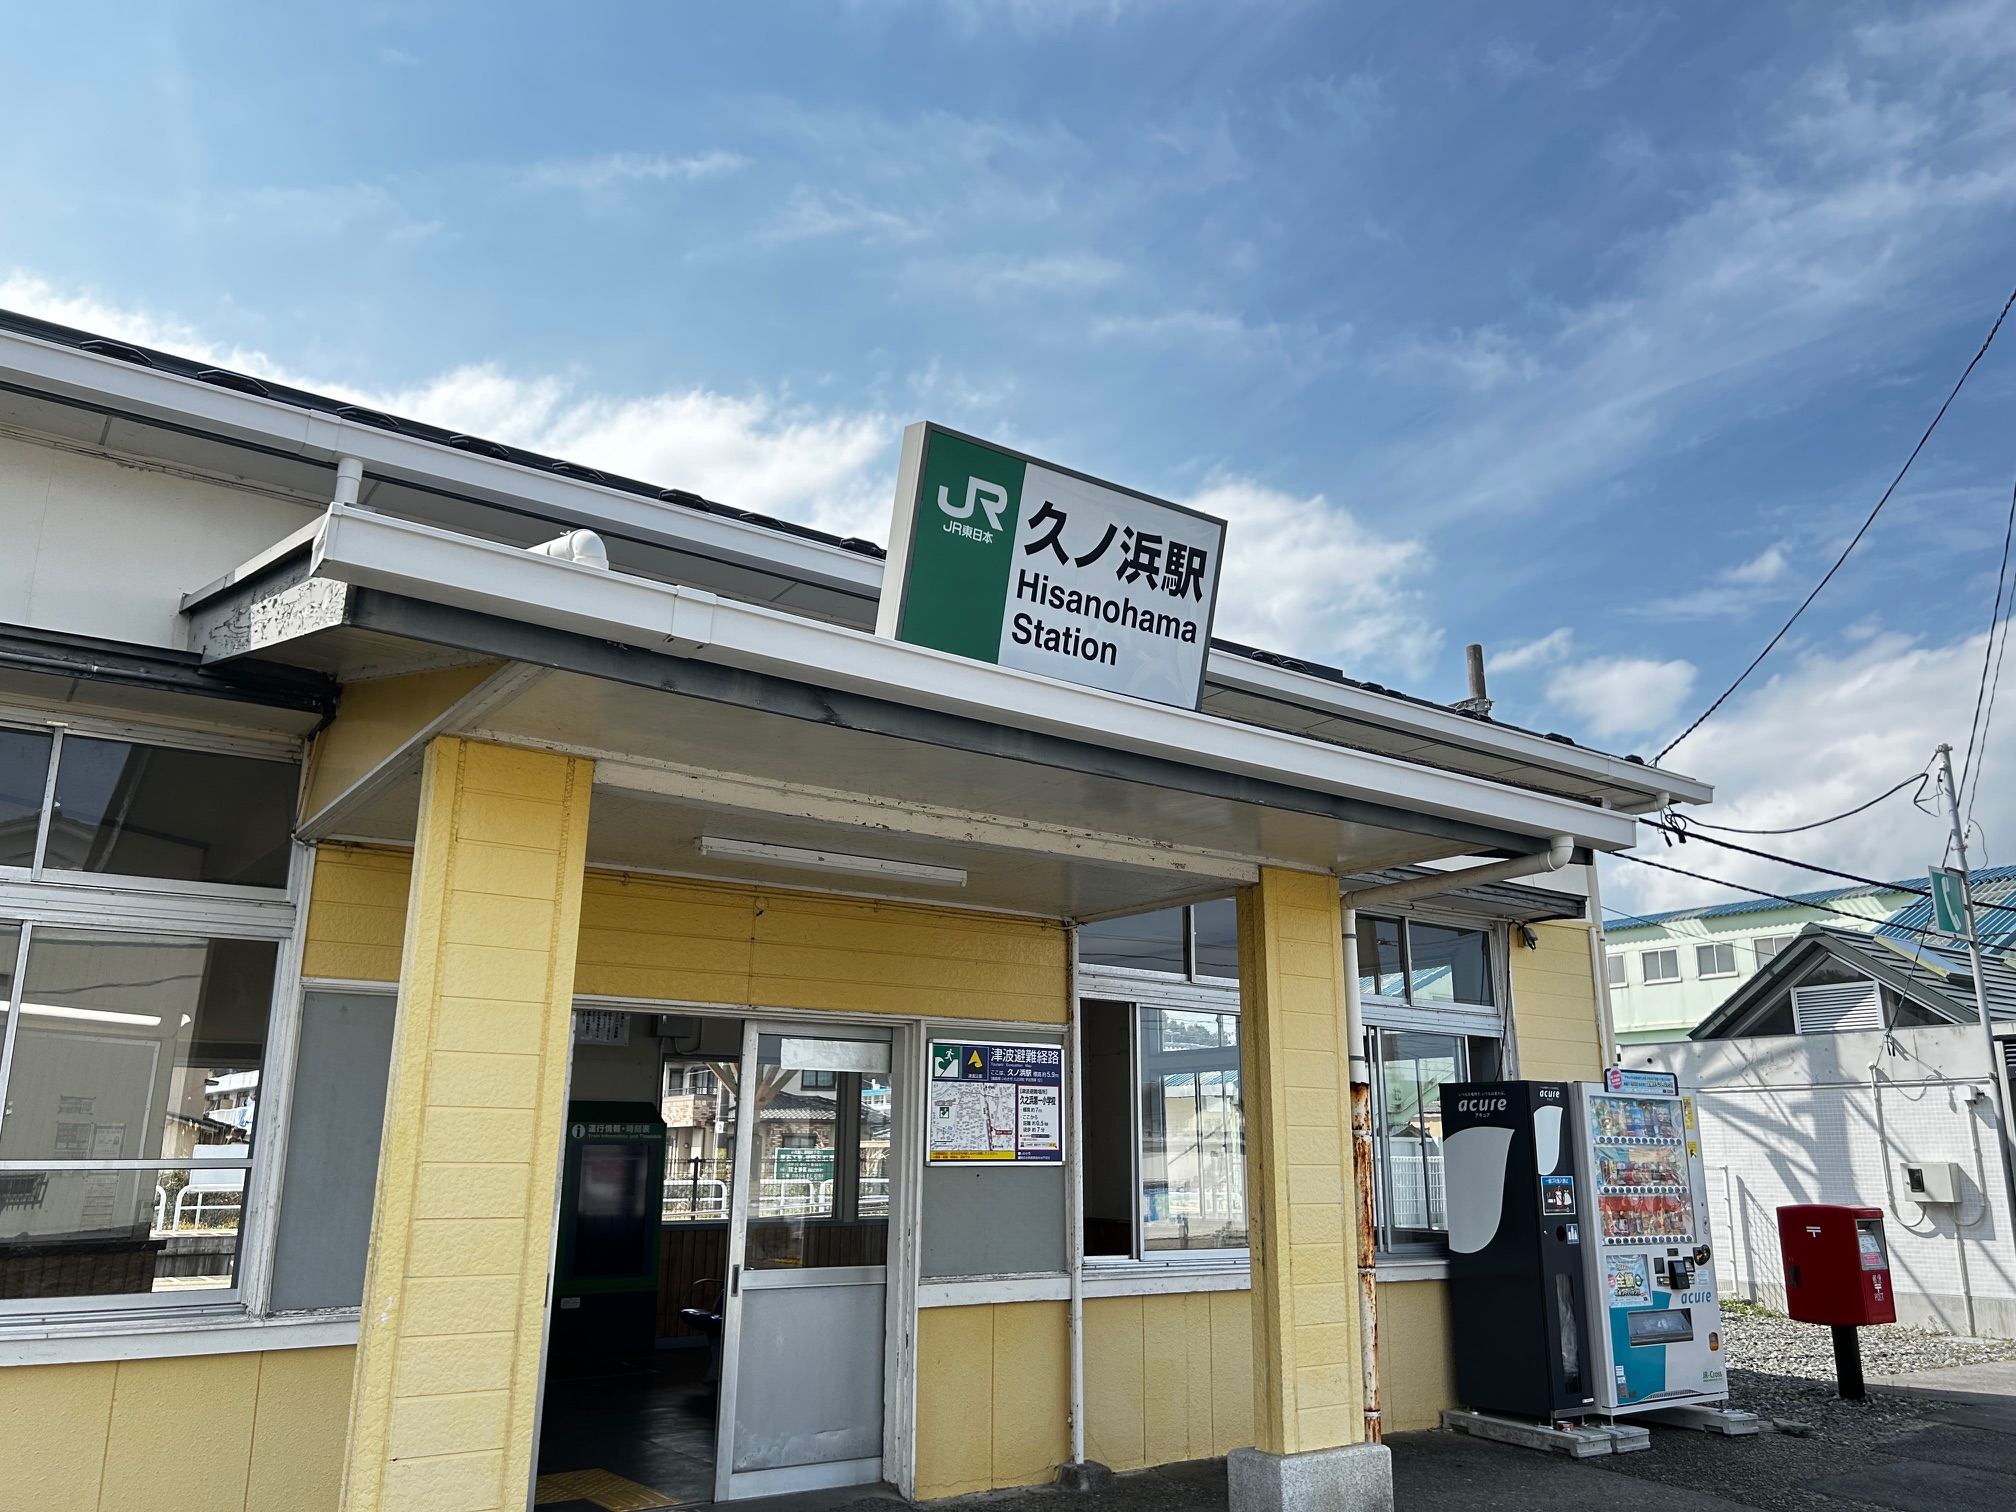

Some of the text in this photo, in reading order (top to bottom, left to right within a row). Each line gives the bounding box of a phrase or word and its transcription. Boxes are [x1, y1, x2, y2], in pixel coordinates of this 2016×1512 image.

[937, 475, 1008, 531] JR
[942, 520, 994, 544] JR東日本
[1023, 500, 1209, 603] 久ノ浜駅
[1015, 568, 1198, 643] Hisanohama
[1011, 612, 1118, 666] Station
[990, 1047, 1060, 1065] 津波避難経路
[1458, 1098, 1508, 1112] acure
[1539, 1089, 1560, 1098] acure
[1681, 1291, 1712, 1305] acure
